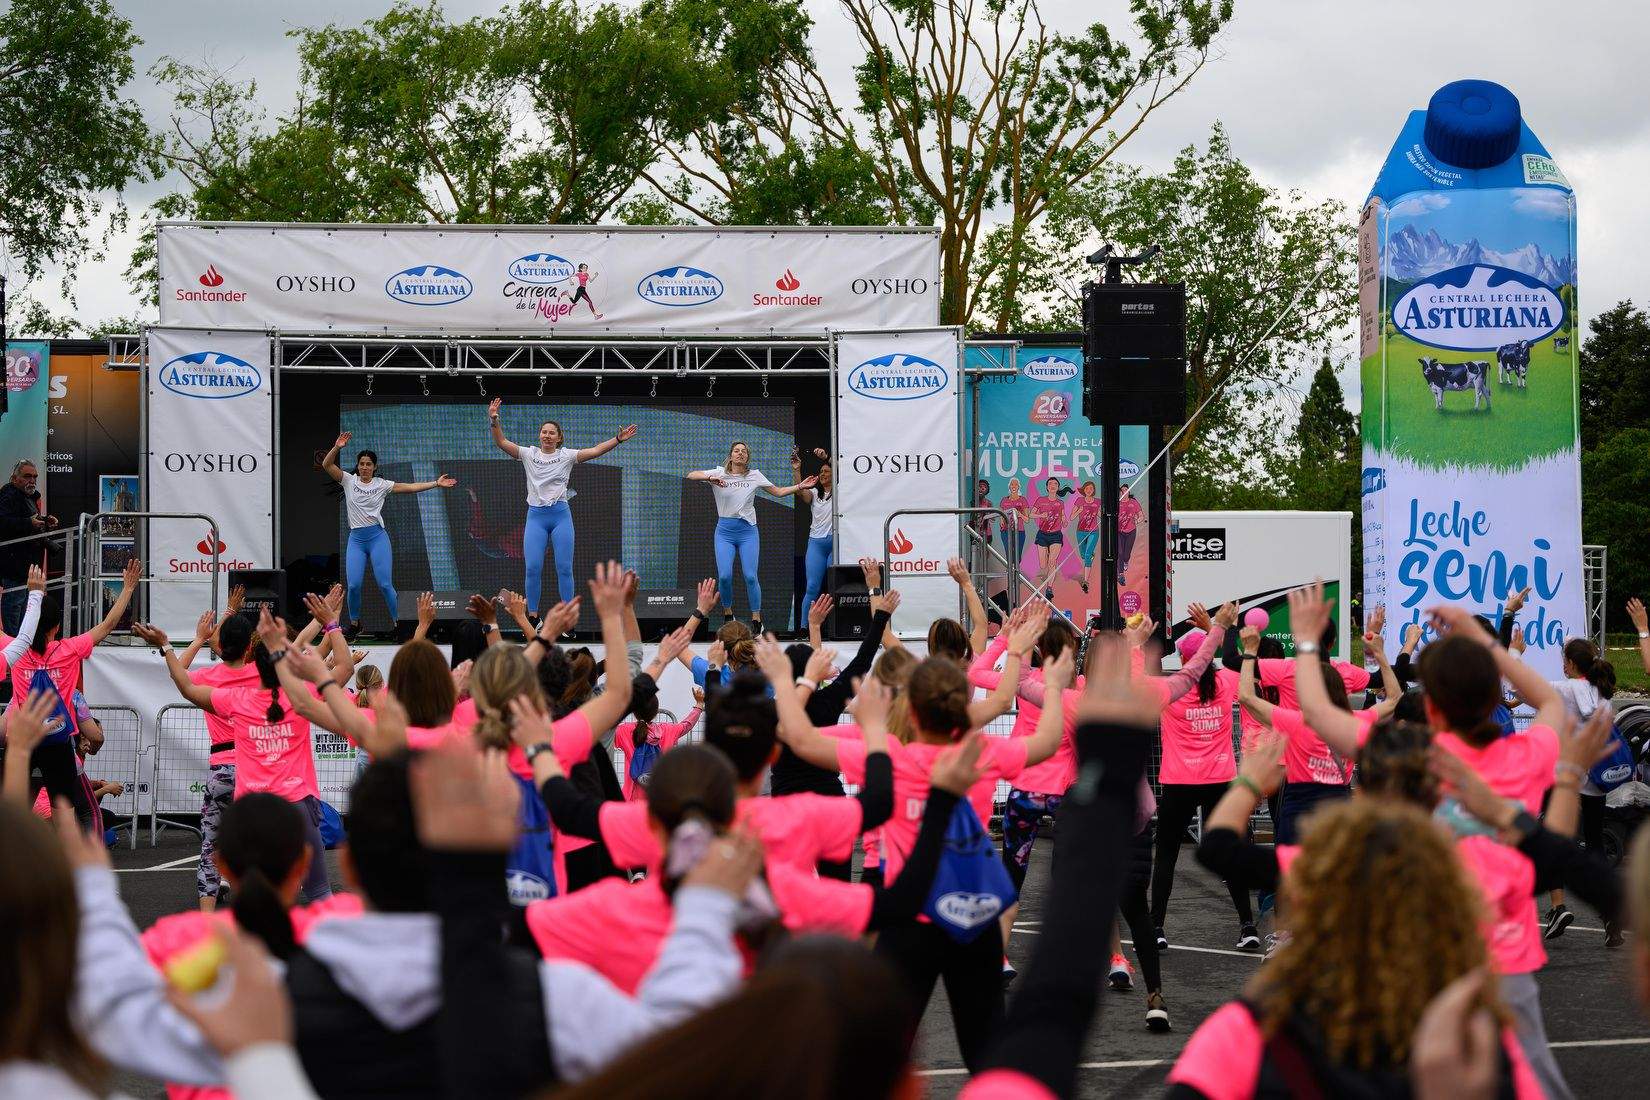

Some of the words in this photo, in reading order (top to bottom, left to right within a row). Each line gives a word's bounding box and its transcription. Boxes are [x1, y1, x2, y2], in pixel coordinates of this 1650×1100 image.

[1528, 161, 1556, 171] CERO
[513, 264, 570, 277] ASTURIANA
[276, 275, 356, 293] OYSHO
[392, 278, 466, 296] ASTURIANA
[502, 282, 558, 298] Carrera
[643, 281, 717, 297] ASTURIANA
[851, 278, 928, 295] OYSHO
[176, 288, 247, 302] Santander
[753, 293, 823, 306] Santander
[1429, 294, 1486, 304] CENTRAL
[1490, 294, 1547, 303] LECHERA
[515, 299, 528, 310] de
[528, 298, 536, 310] la
[535, 297, 576, 323] Mujer
[1402, 296, 1554, 330] ASTURIANA
[166, 366, 255, 388] ASTURIANA
[1026, 365, 1075, 376] ASTURIANA
[855, 371, 941, 389] ASTURIANA
[1037, 395, 1064, 414] 20
[1074, 438, 1088, 447] DE
[164, 452, 257, 474] OYSHO
[853, 453, 944, 475] OYSHO
[965, 448, 1096, 478] MUJER
[1402, 498, 1491, 552] Leche
[1172, 552, 1224, 560] rent-a-car
[859, 557, 940, 572] ander
[1397, 538, 1563, 609] semi
[1399, 603, 1569, 651] detda
[1186, 706, 1224, 720] DORSAL
[248, 723, 295, 740] DORSAL
[1191, 719, 1220, 732] SUMA
[255, 738, 290, 753] SUMA
[315, 744, 349, 753] GASTEIZ
